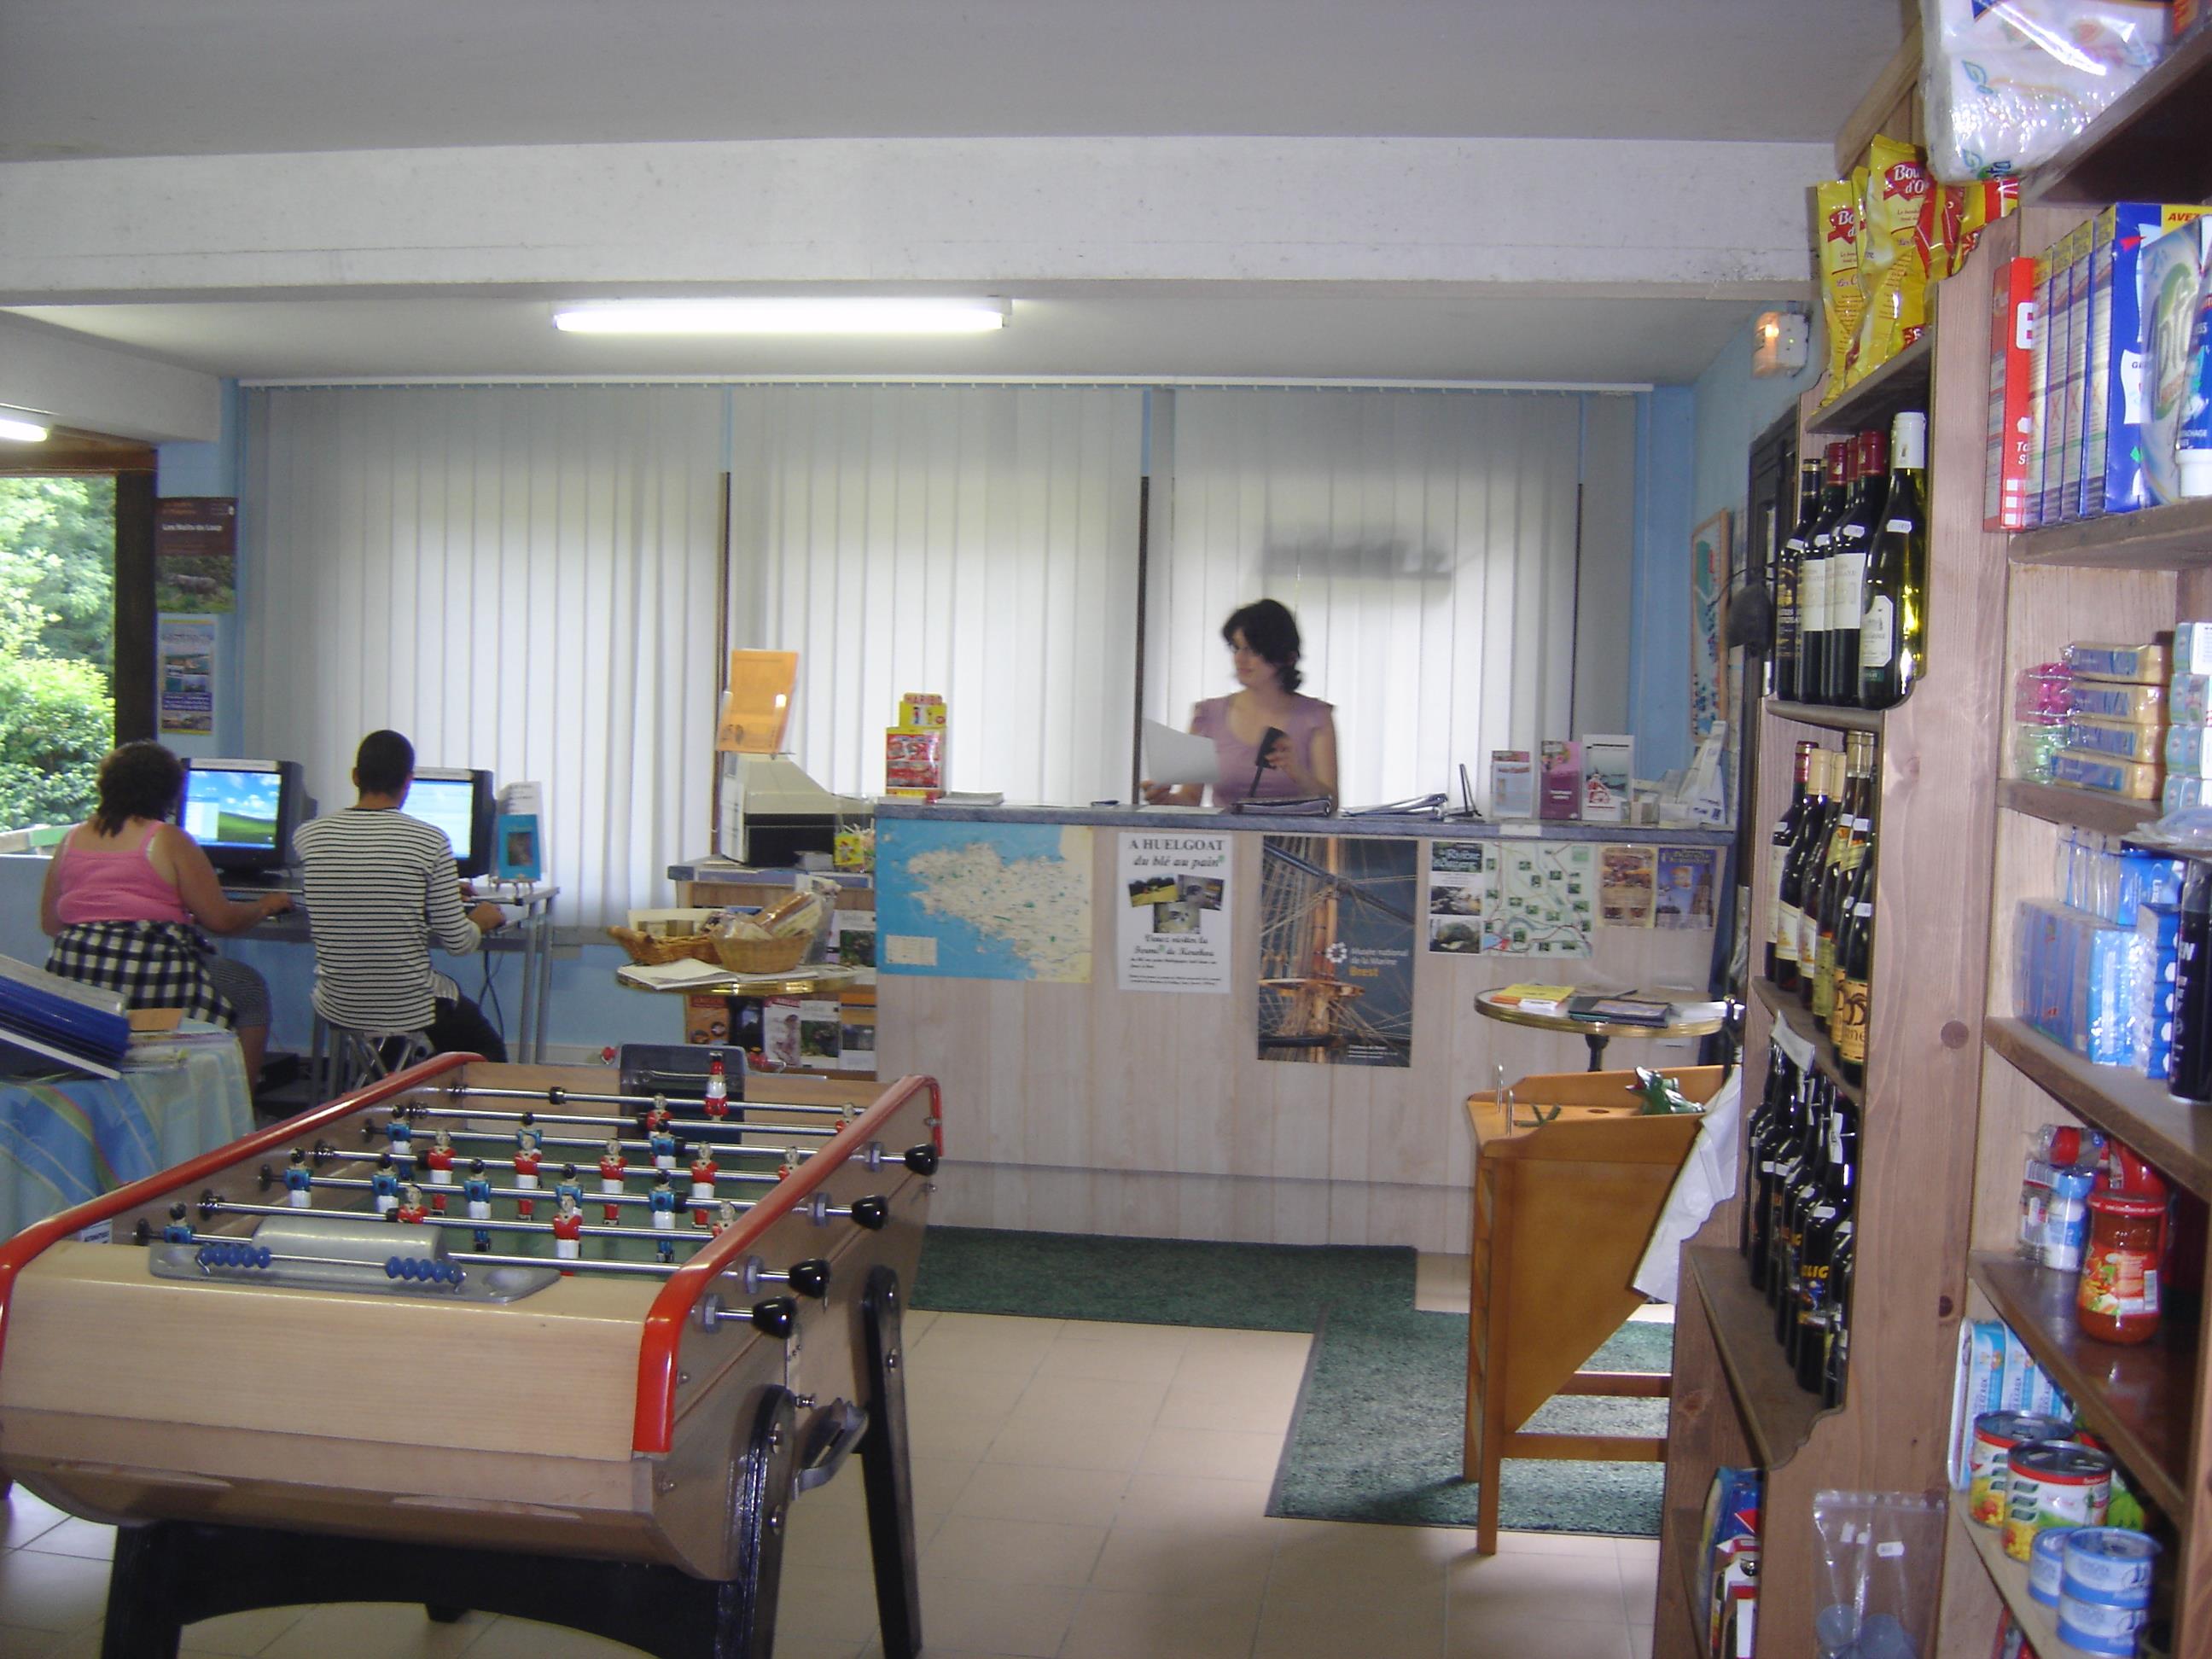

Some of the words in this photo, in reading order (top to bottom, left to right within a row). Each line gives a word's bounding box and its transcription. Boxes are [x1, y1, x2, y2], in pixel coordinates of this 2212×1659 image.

[1894, 165, 1921, 181] Bou
[1143, 838, 1225, 851] HUELGOAT
[1133, 855, 1150, 866] du
[1153, 855, 1172, 866] blé
[1190, 857, 1220, 870] pain
